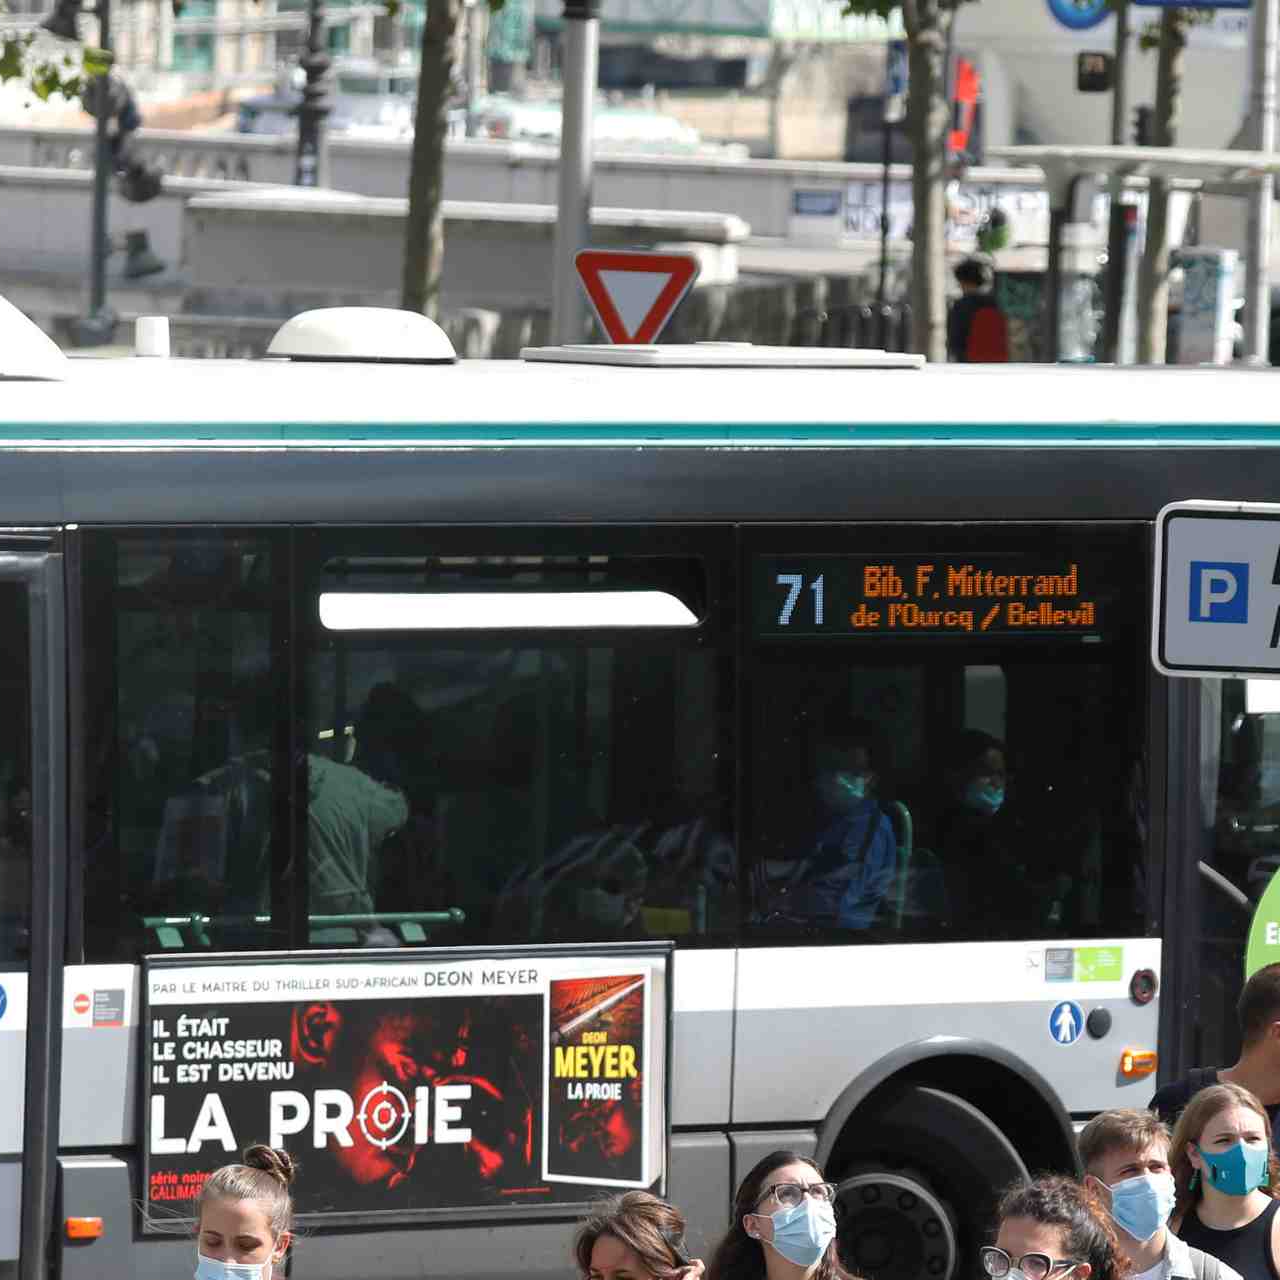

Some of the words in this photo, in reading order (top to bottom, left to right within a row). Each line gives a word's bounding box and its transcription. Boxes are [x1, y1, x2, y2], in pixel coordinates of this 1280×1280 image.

[863, 564, 910, 600] Bib.
[917, 564, 941, 600] F.
[948, 563, 1080, 599] Mitterrand
[775, 573, 826, 627] 71
[850, 602, 880, 630] de
[152, 982, 178, 994] PAR
[182, 982, 198, 994] LE
[253, 980, 271, 993] DU
[275, 977, 331, 992] THRILLER
[335, 975, 419, 991] SUD-AFRICAIN
[422, 970, 474, 988] DEON
[480, 968, 539, 987] MEYER
[152, 1019, 170, 1039] IL
[177, 1013, 229, 1037] ÉTAIT
[581, 1031, 608, 1045] DEON
[152, 1041, 176, 1061] LE
[182, 1039, 282, 1060] CHASSEUR
[554, 1045, 639, 1079] MEYER
[152, 1064, 170, 1084] IL
[177, 1062, 213, 1082] EST
[218, 1060, 295, 1081] DEVENU
[567, 1083, 583, 1100] LA
[586, 1082, 622, 1100] PROIE
[150, 1093, 238, 1155] LA
[269, 1080, 473, 1152] PROIE
[182, 1170, 211, 1184] noir
